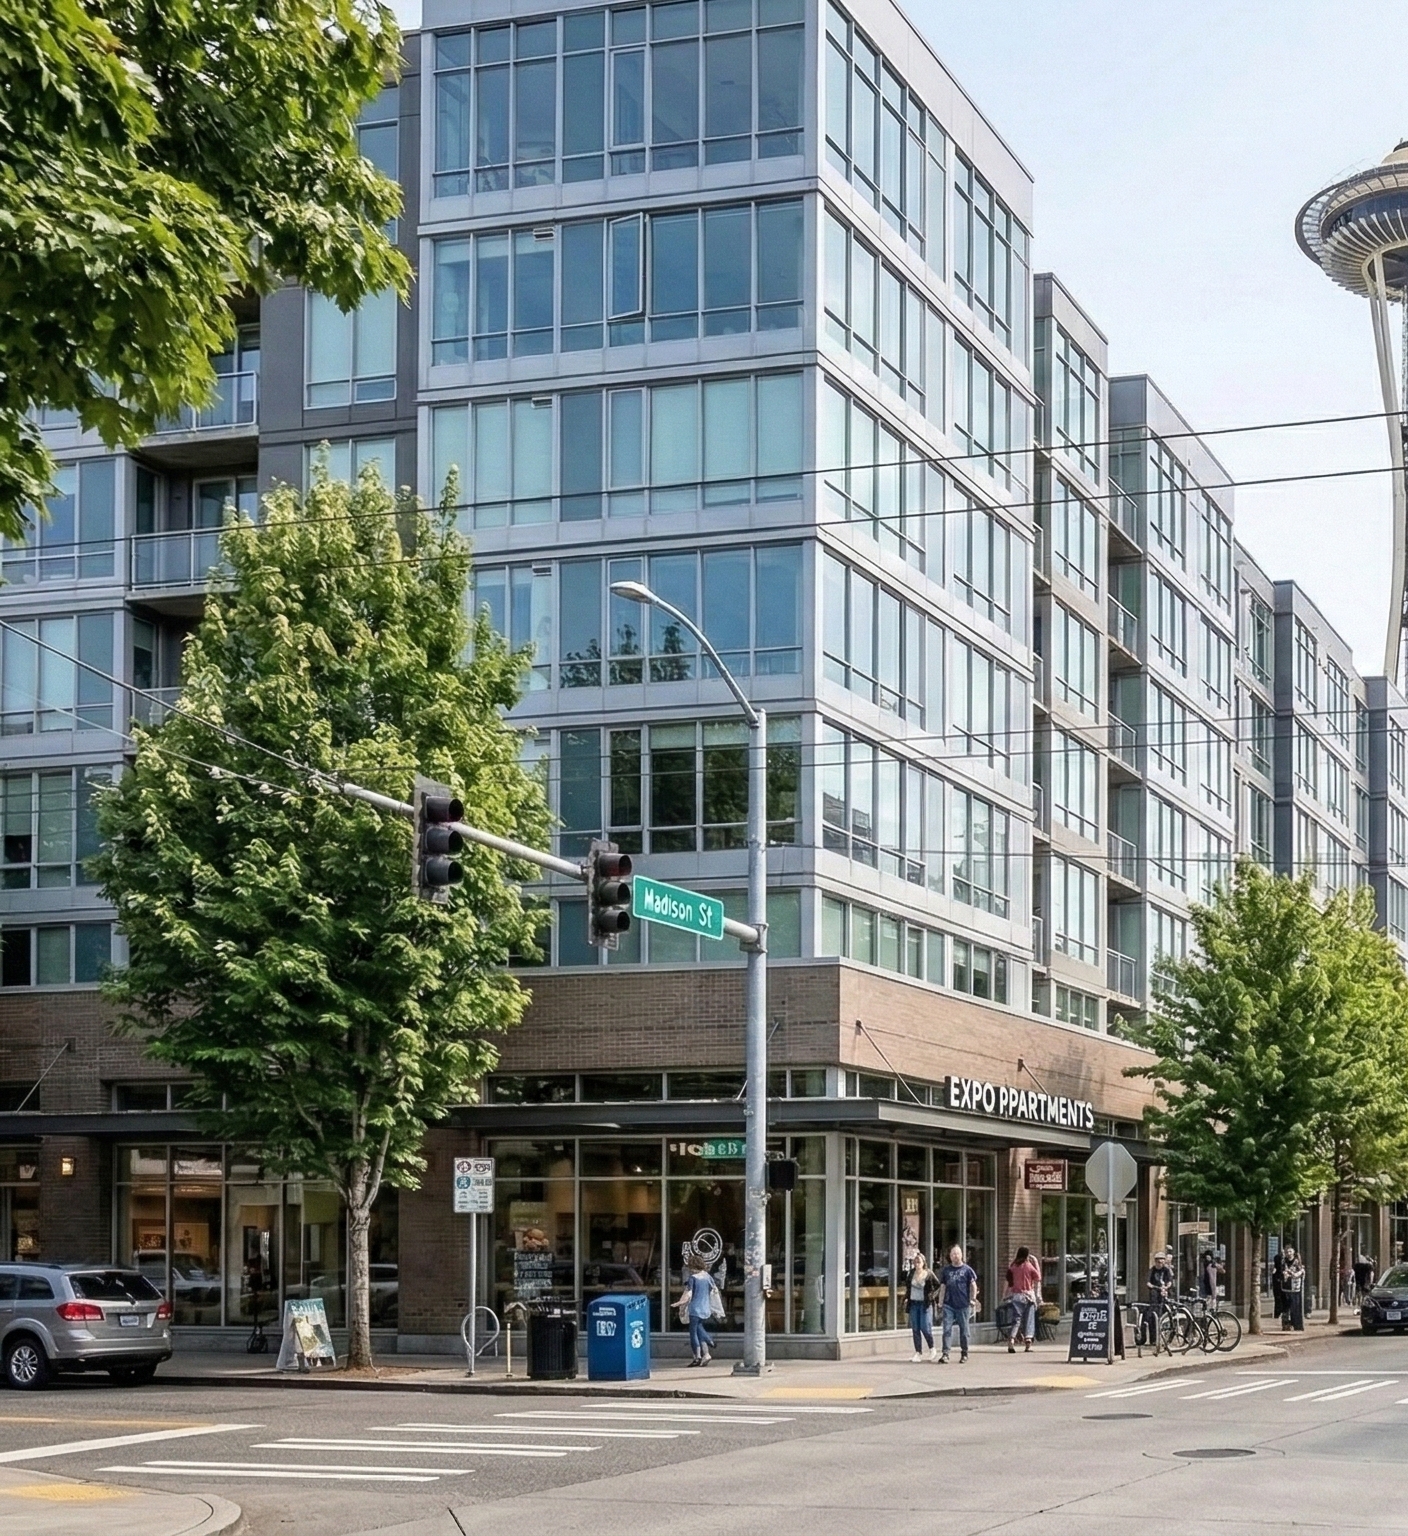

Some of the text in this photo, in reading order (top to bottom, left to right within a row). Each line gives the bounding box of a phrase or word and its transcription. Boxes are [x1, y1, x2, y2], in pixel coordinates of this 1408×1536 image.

[644, 887, 713, 928] Madison St
[950, 1076, 995, 1112] EXPO
